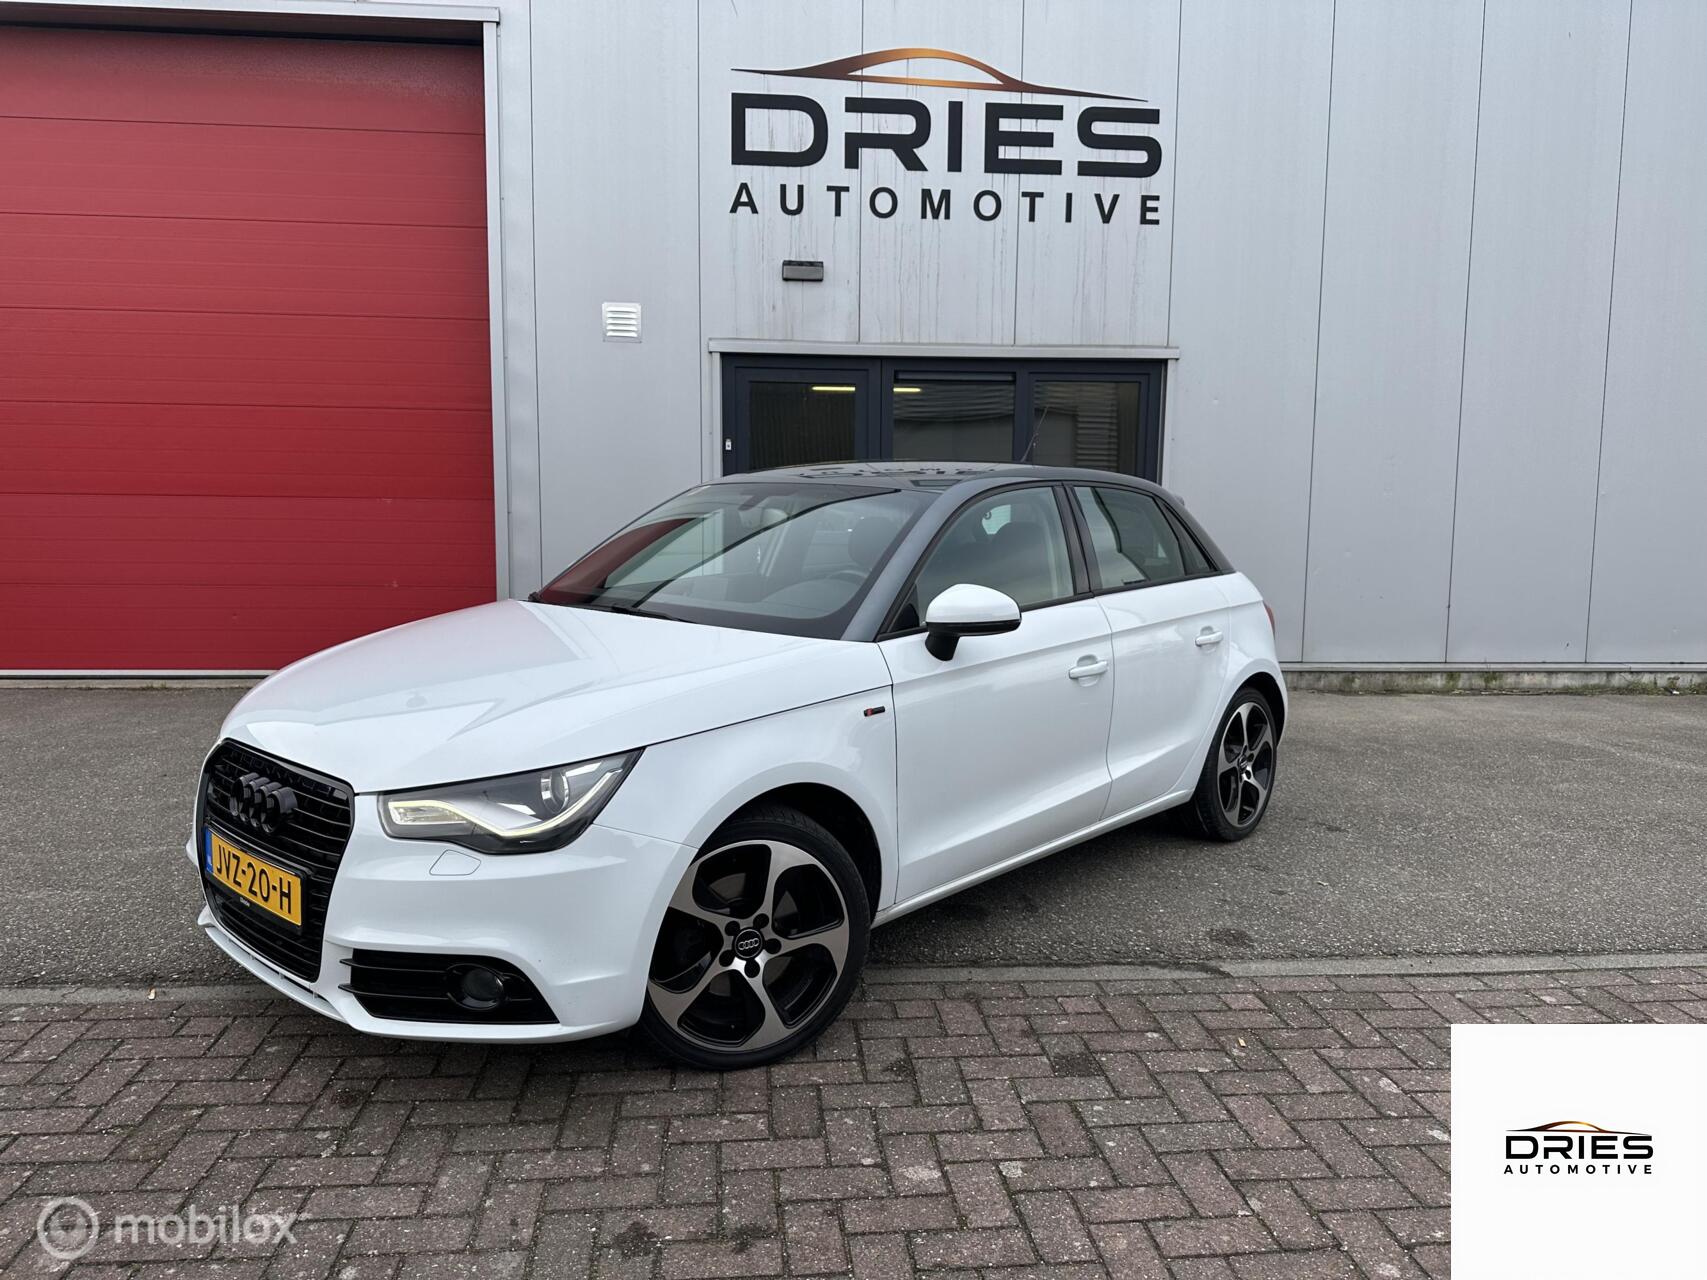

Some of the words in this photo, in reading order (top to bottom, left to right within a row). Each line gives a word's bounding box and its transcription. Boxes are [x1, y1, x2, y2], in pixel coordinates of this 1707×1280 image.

[731, 92, 1163, 179] DRIES
[729, 182, 1161, 226] AUTOMOTIVE
[216, 843, 292, 915] JVZ-20-H
